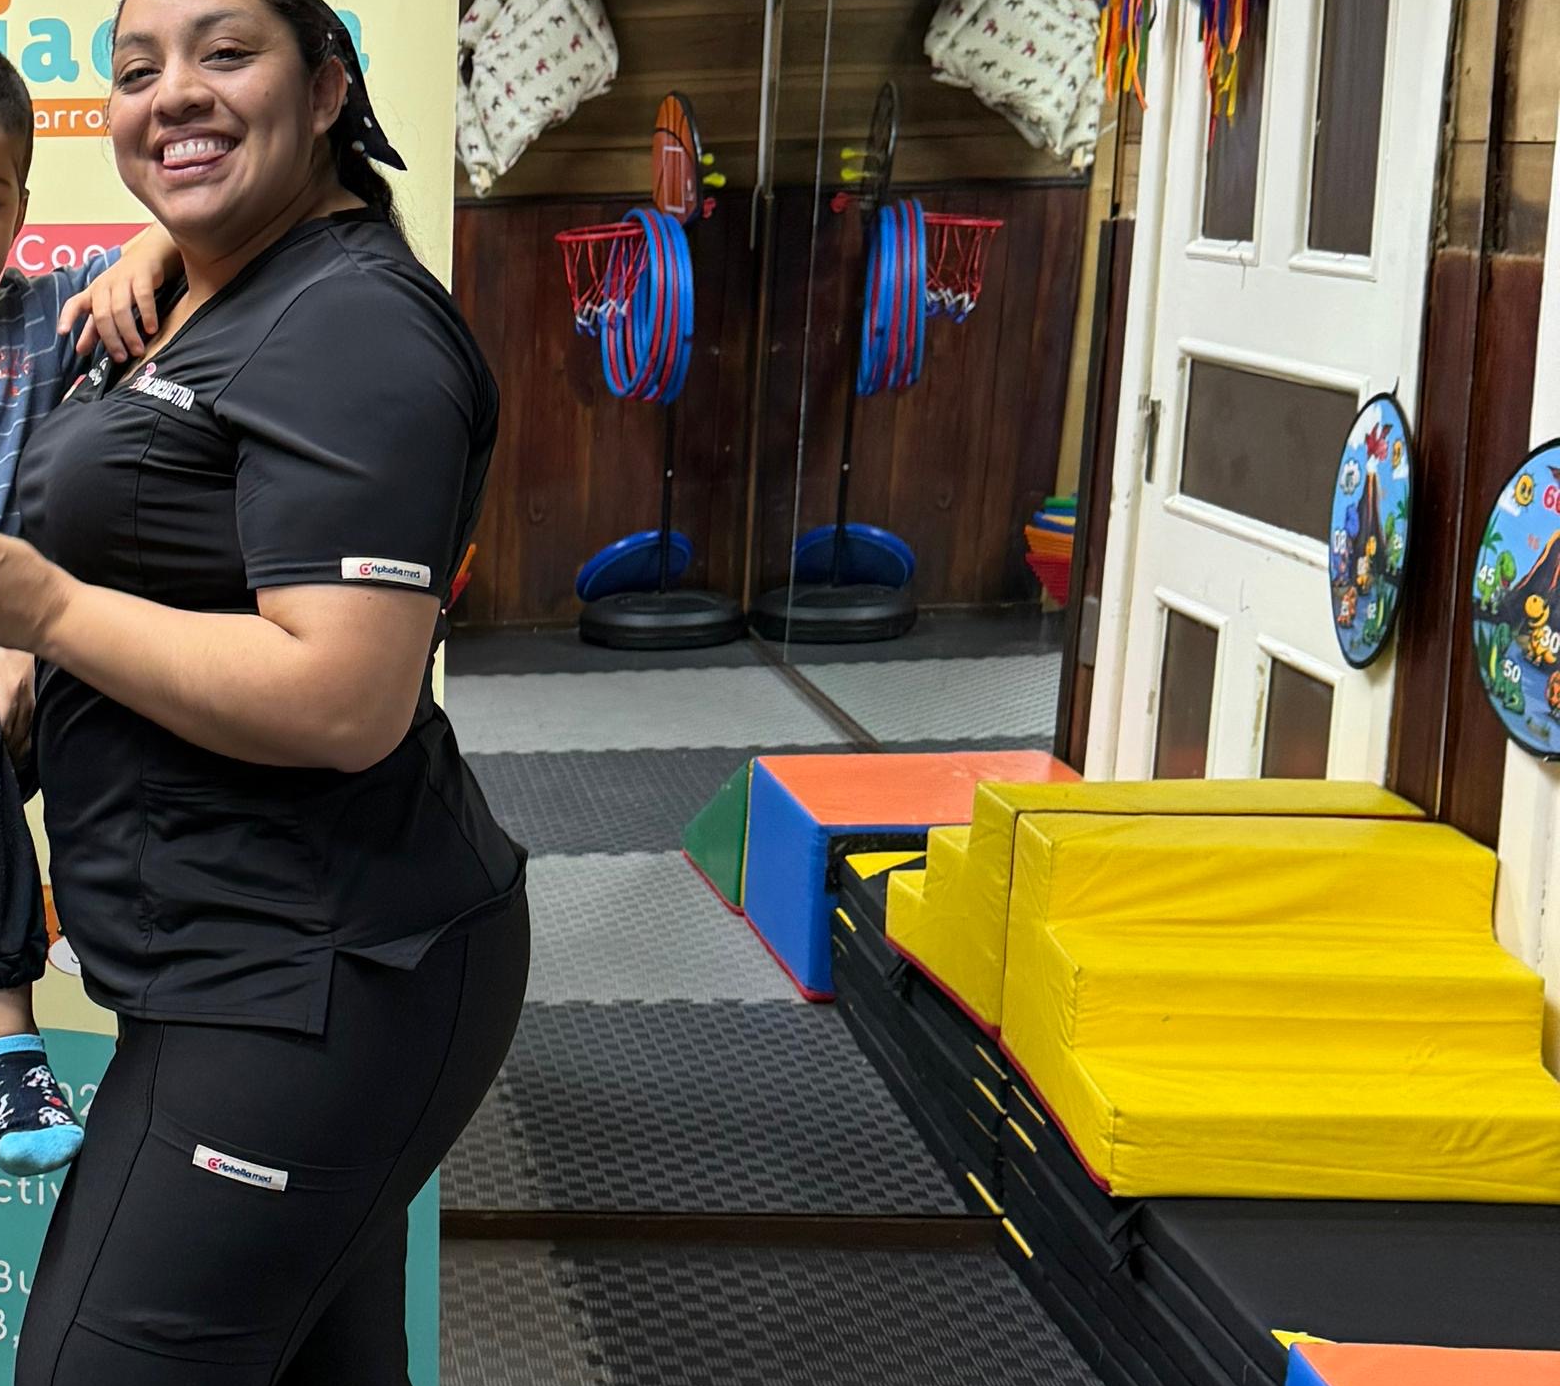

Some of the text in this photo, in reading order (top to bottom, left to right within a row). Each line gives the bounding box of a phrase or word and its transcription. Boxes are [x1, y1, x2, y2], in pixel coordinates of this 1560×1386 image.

[1479, 565, 1496, 586] 45
[1540, 625, 1560, 654] 30
[1503, 659, 1522, 683] 50
